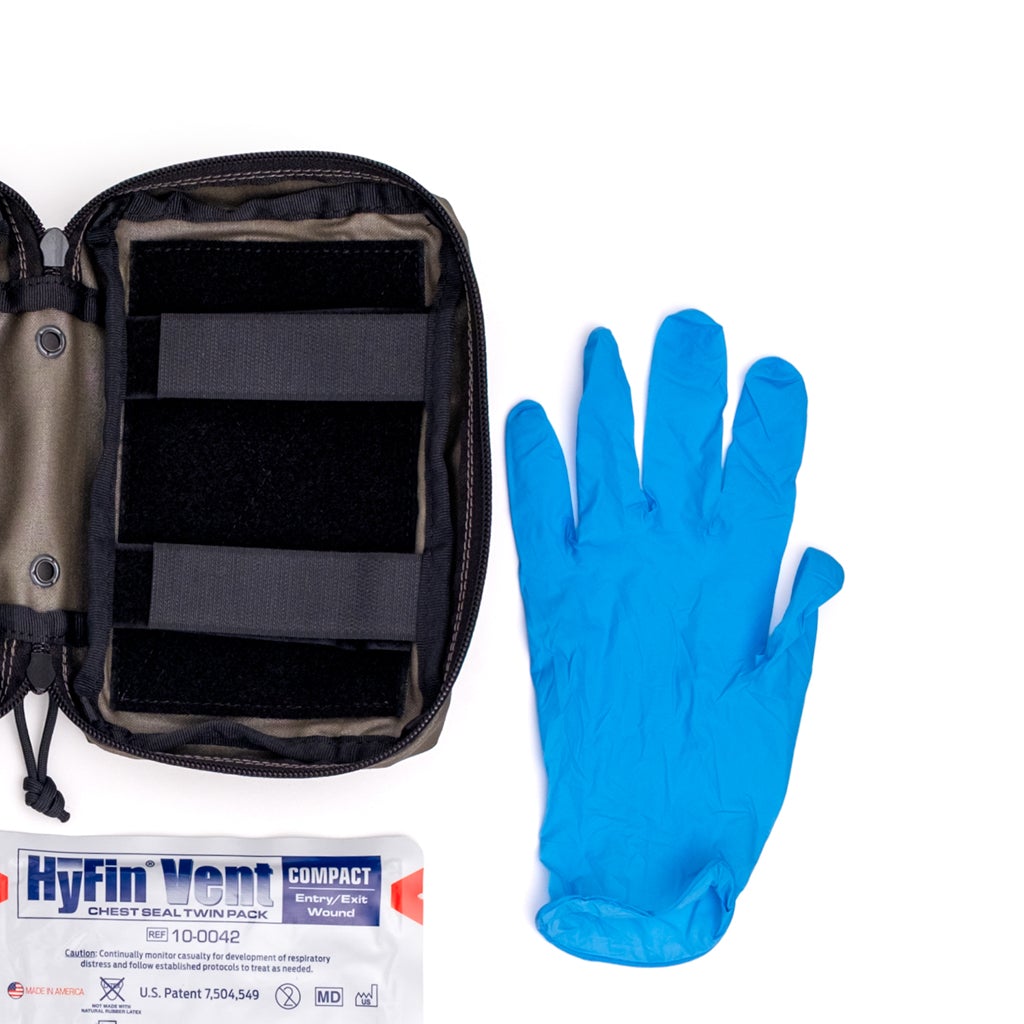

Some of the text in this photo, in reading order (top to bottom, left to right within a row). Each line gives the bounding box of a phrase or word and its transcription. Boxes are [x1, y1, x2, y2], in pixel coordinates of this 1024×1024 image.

[288, 867, 371, 885] COMPACT
[160, 858, 274, 907] Vent
[296, 894, 368, 905] Entry/Exit
[88, 907, 268, 919] CHEST SEAL TWIN PACK
[308, 908, 355, 918] Wound
[148, 929, 240, 944] REF 10-0042
[65, 949, 97, 958] Caution:
[99, 950, 143, 960] Continually
[145, 951, 176, 959] monitor
[178, 952, 210, 962] casualty
[226, 953, 276, 963] development
[288, 955, 330, 963] respiratory
[156, 962, 201, 970] established
[202, 963, 239, 972] protocols
[282, 965, 313, 973] needed.
[26, 987, 45, 995] MADE
[47, 987, 54, 995] IN
[140, 987, 259, 1001] U.S. Patent 7,504,549
[317, 991, 340, 1003] MD
